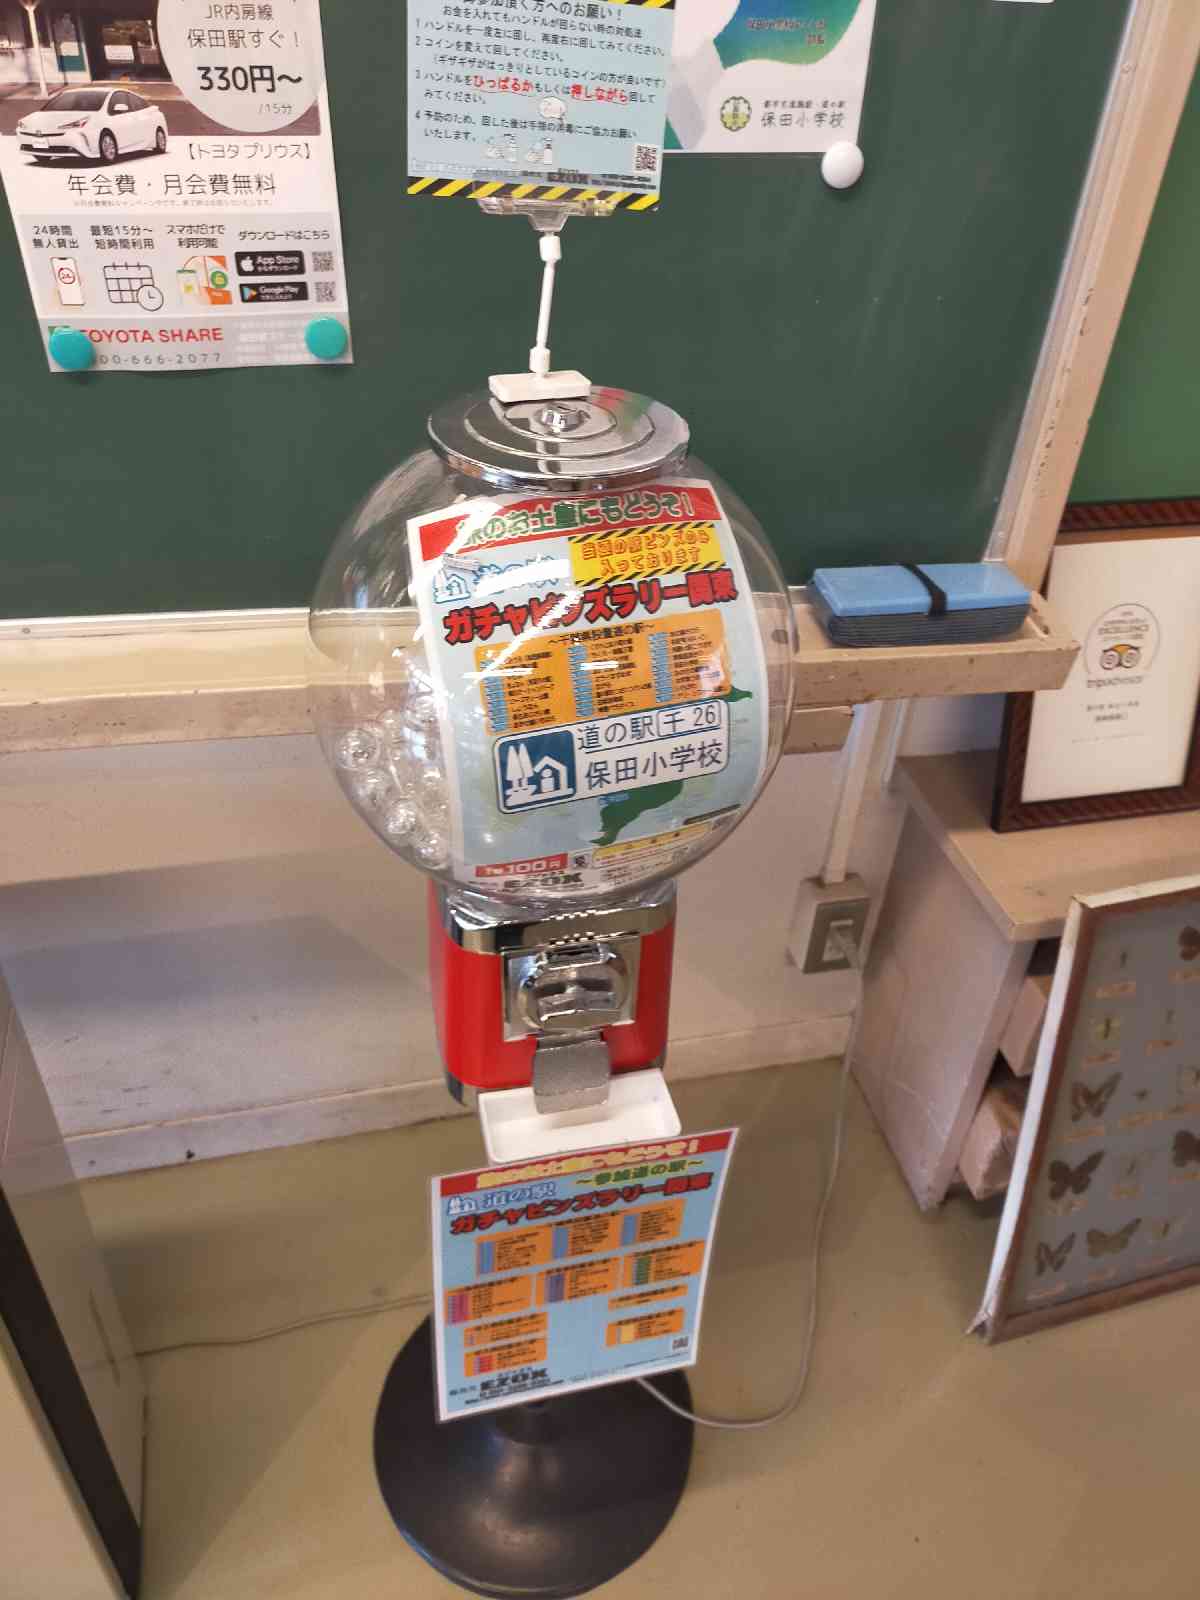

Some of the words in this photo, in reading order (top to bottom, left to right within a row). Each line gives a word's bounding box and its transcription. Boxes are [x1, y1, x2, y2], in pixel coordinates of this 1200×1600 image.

[205, 3, 274, 20] JR内房線
[187, 29, 301, 48] 保田駅すぐ！
[760, 112, 845, 128] 保田小学校
[67, 173, 277, 196] 年会費・月会費無料
[159, 327, 224, 343] SHARE
[99, 353, 222, 366] 00-666-2077
[456, 490, 695, 547] のお土産にもどうぞ！
[577, 714, 656, 751] 道の駅
[692, 704, 716, 727] 26
[585, 738, 724, 790] 保田小学校
